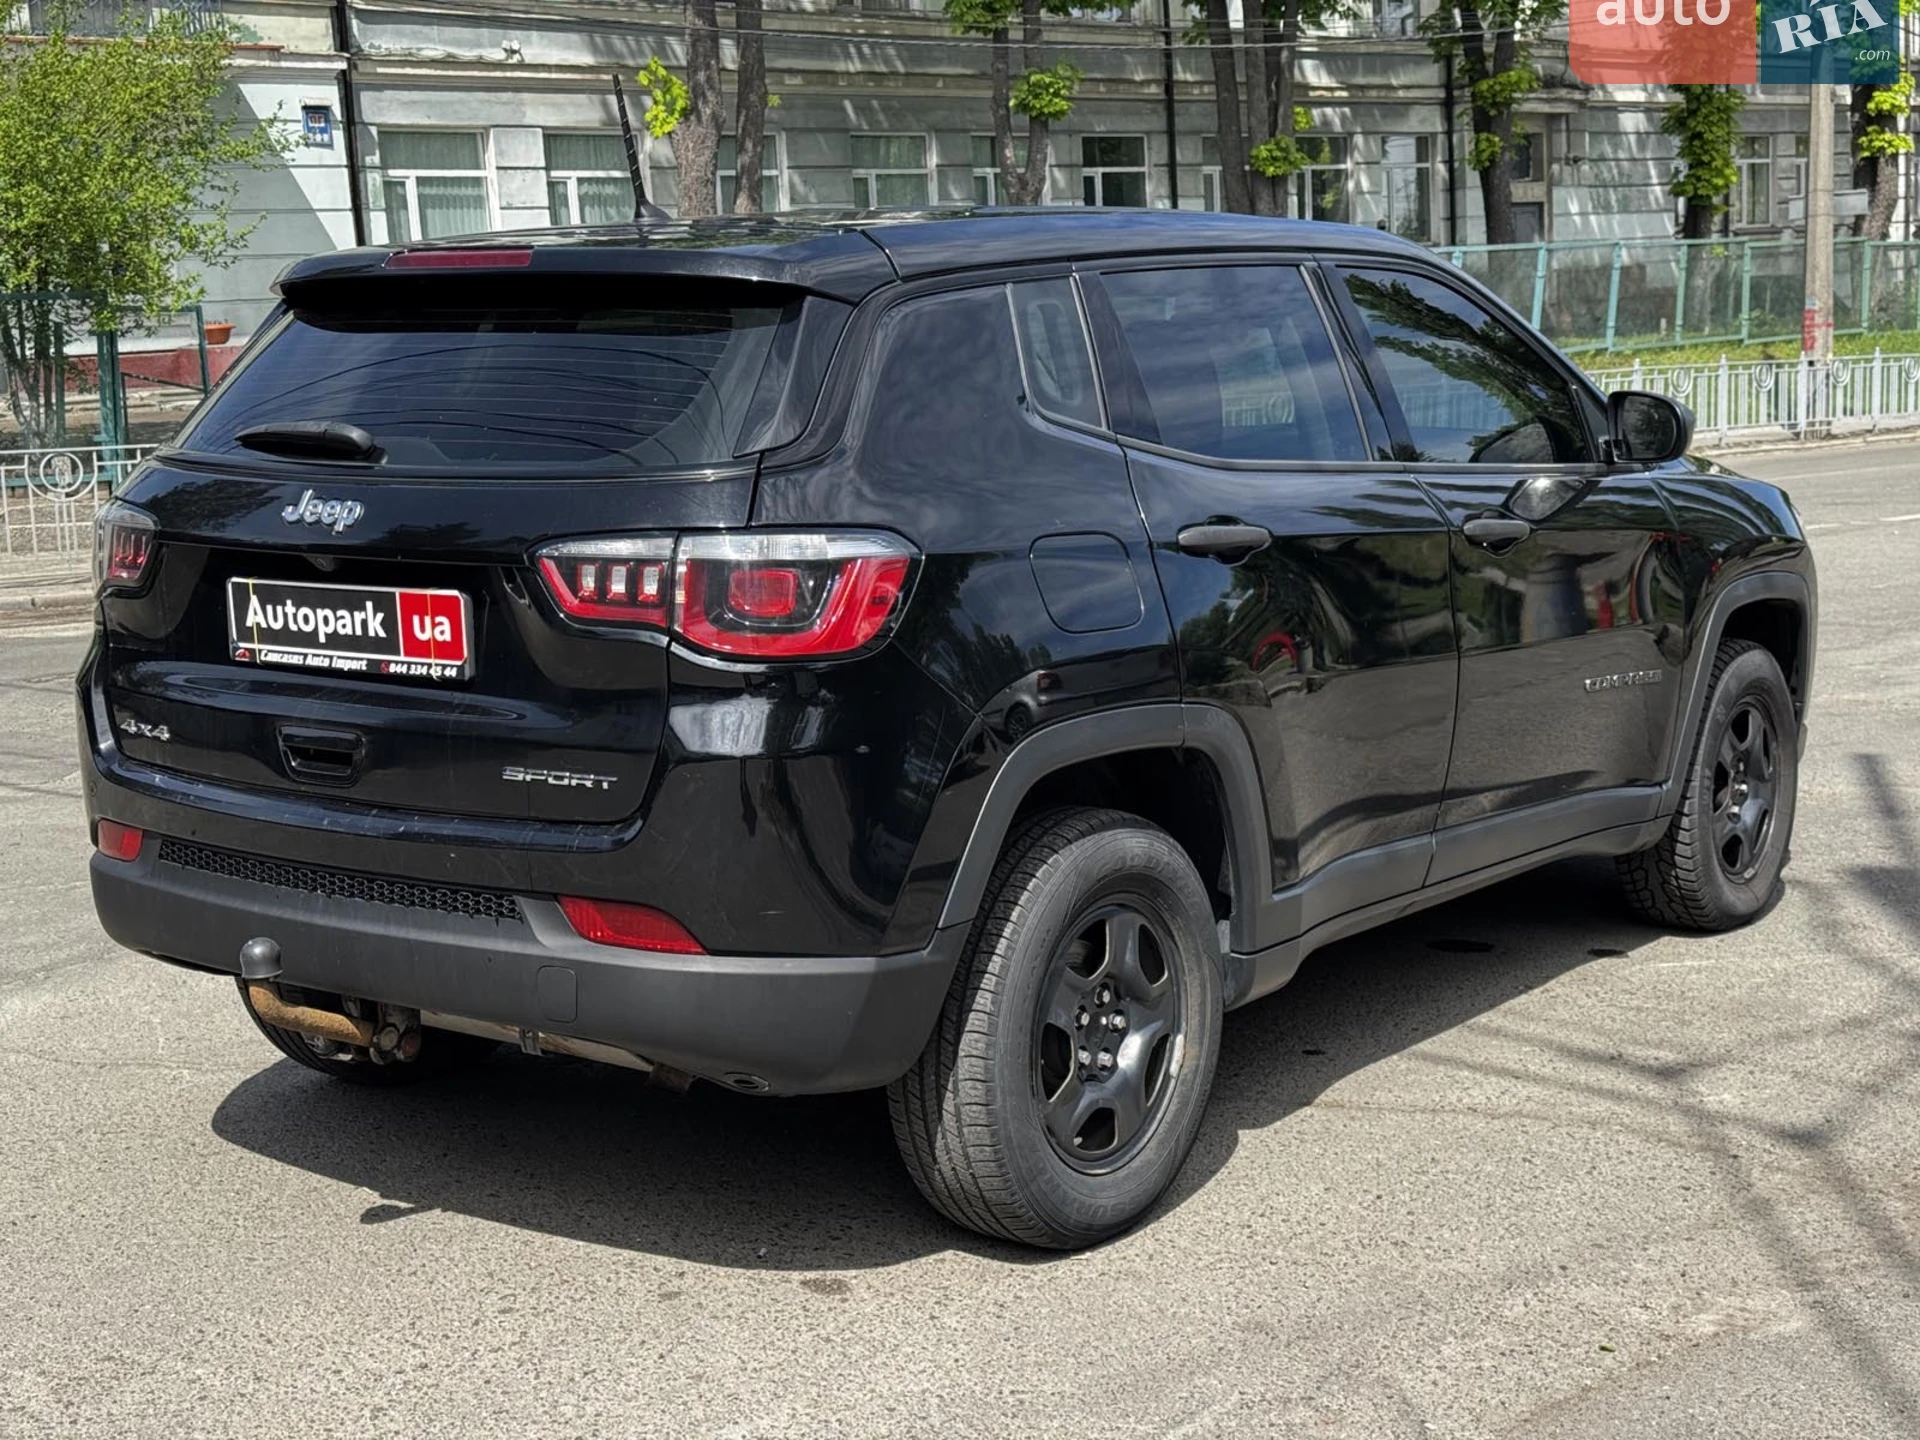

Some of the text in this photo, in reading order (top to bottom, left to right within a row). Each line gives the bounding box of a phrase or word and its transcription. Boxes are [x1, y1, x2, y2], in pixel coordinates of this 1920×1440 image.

[282, 489, 364, 534] Jeep
[245, 594, 452, 643] Autopark ua
[260, 650, 368, 671] Caucasus Auto Import
[409, 664, 428, 676] 334
[443, 666, 458, 678] 44
[502, 766, 618, 790] SPORT
